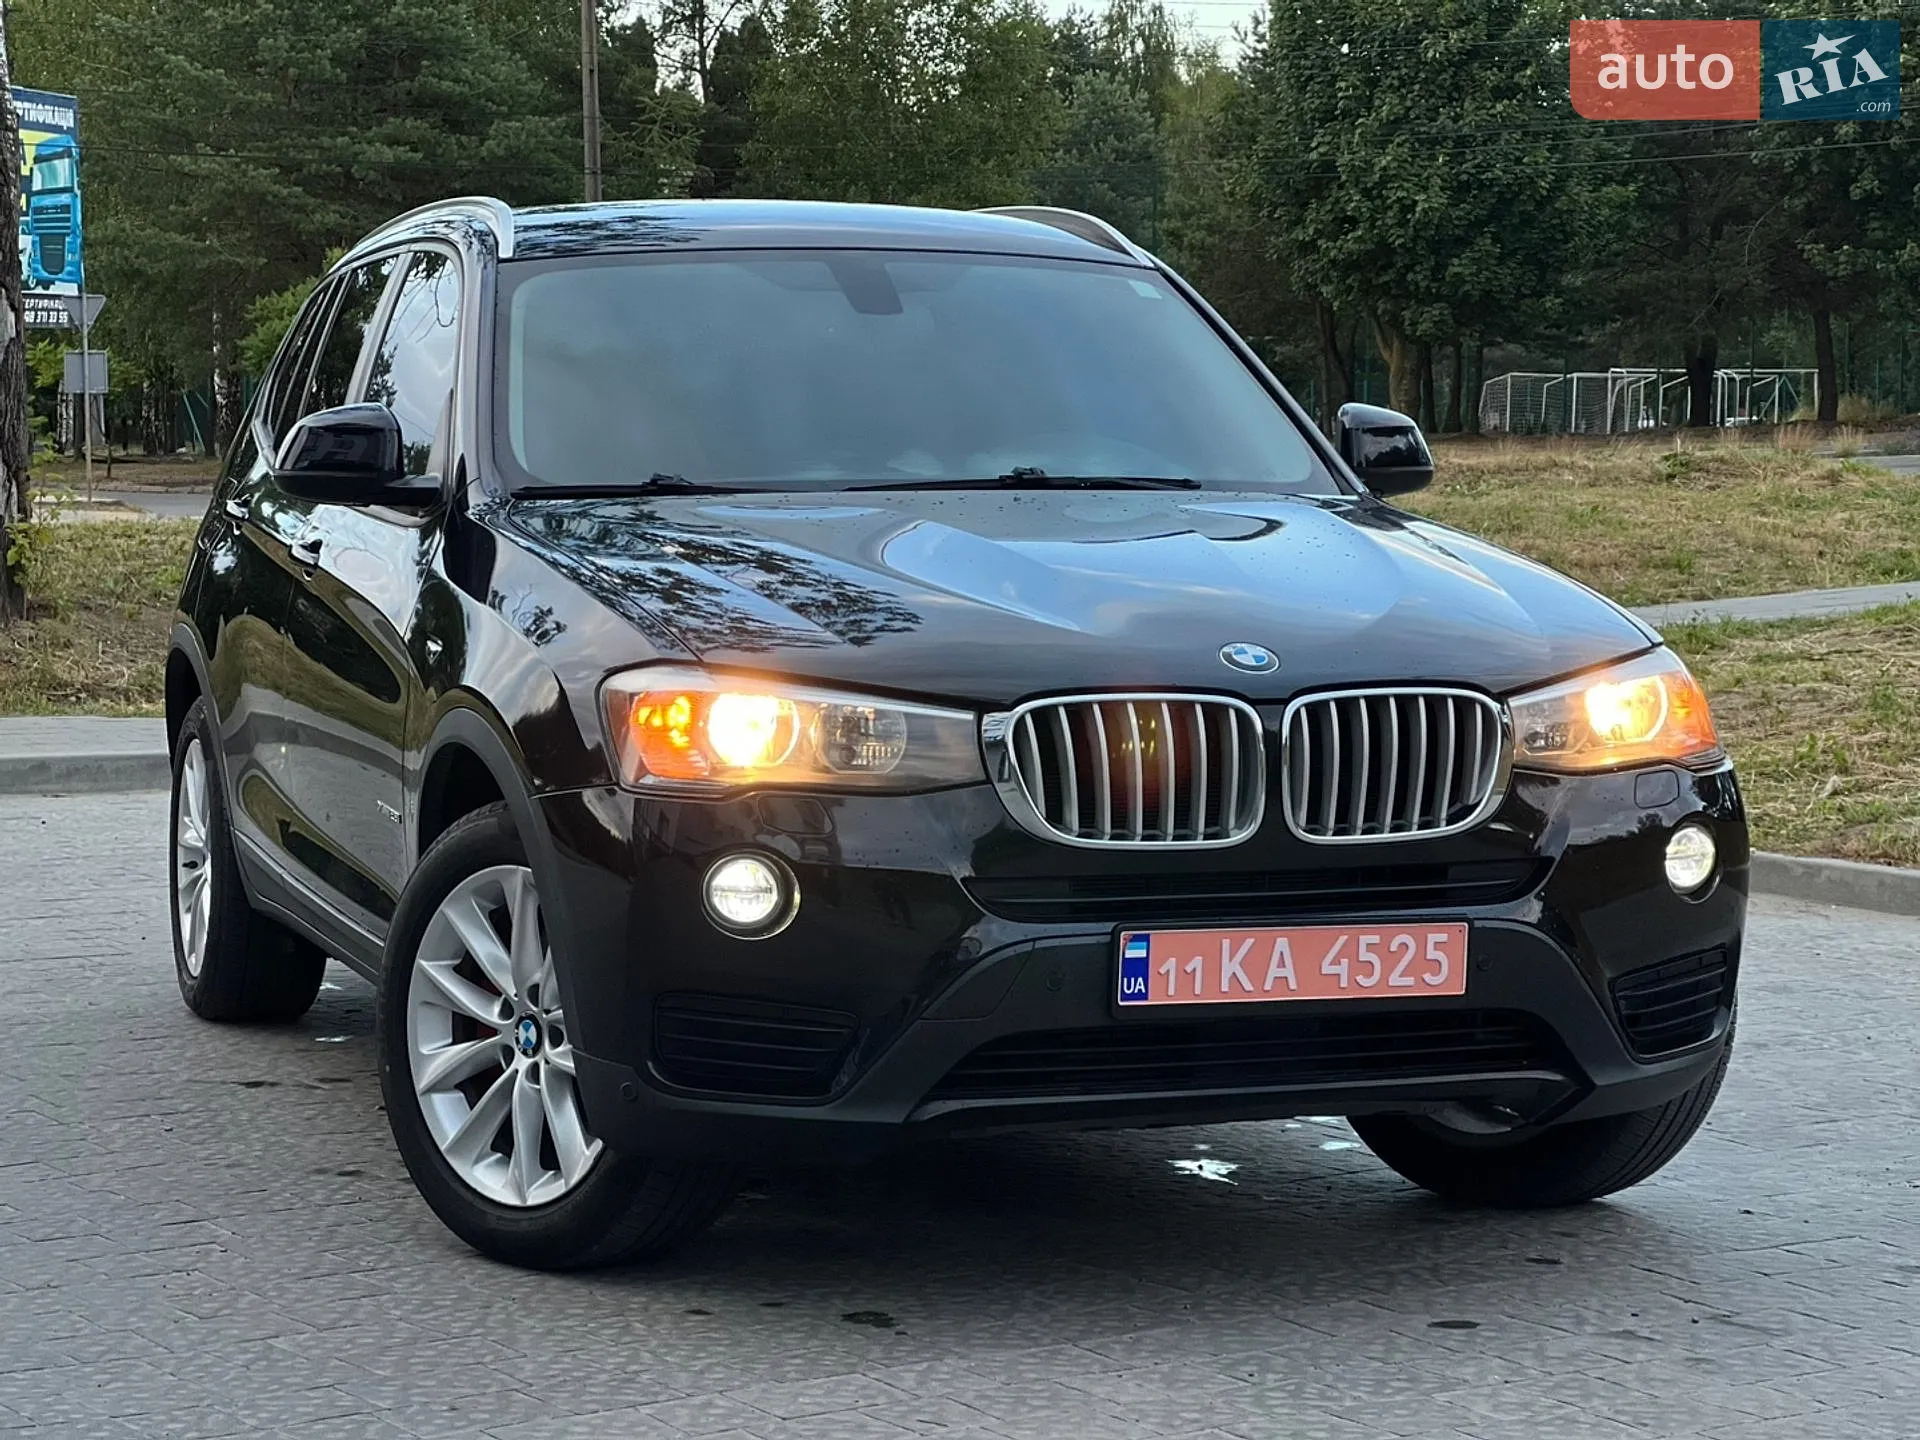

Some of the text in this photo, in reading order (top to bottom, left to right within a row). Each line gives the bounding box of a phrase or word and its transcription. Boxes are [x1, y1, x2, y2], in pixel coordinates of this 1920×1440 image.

[1158, 933, 1450, 997] 11 KA 4525
[1123, 978, 1146, 995] UA
